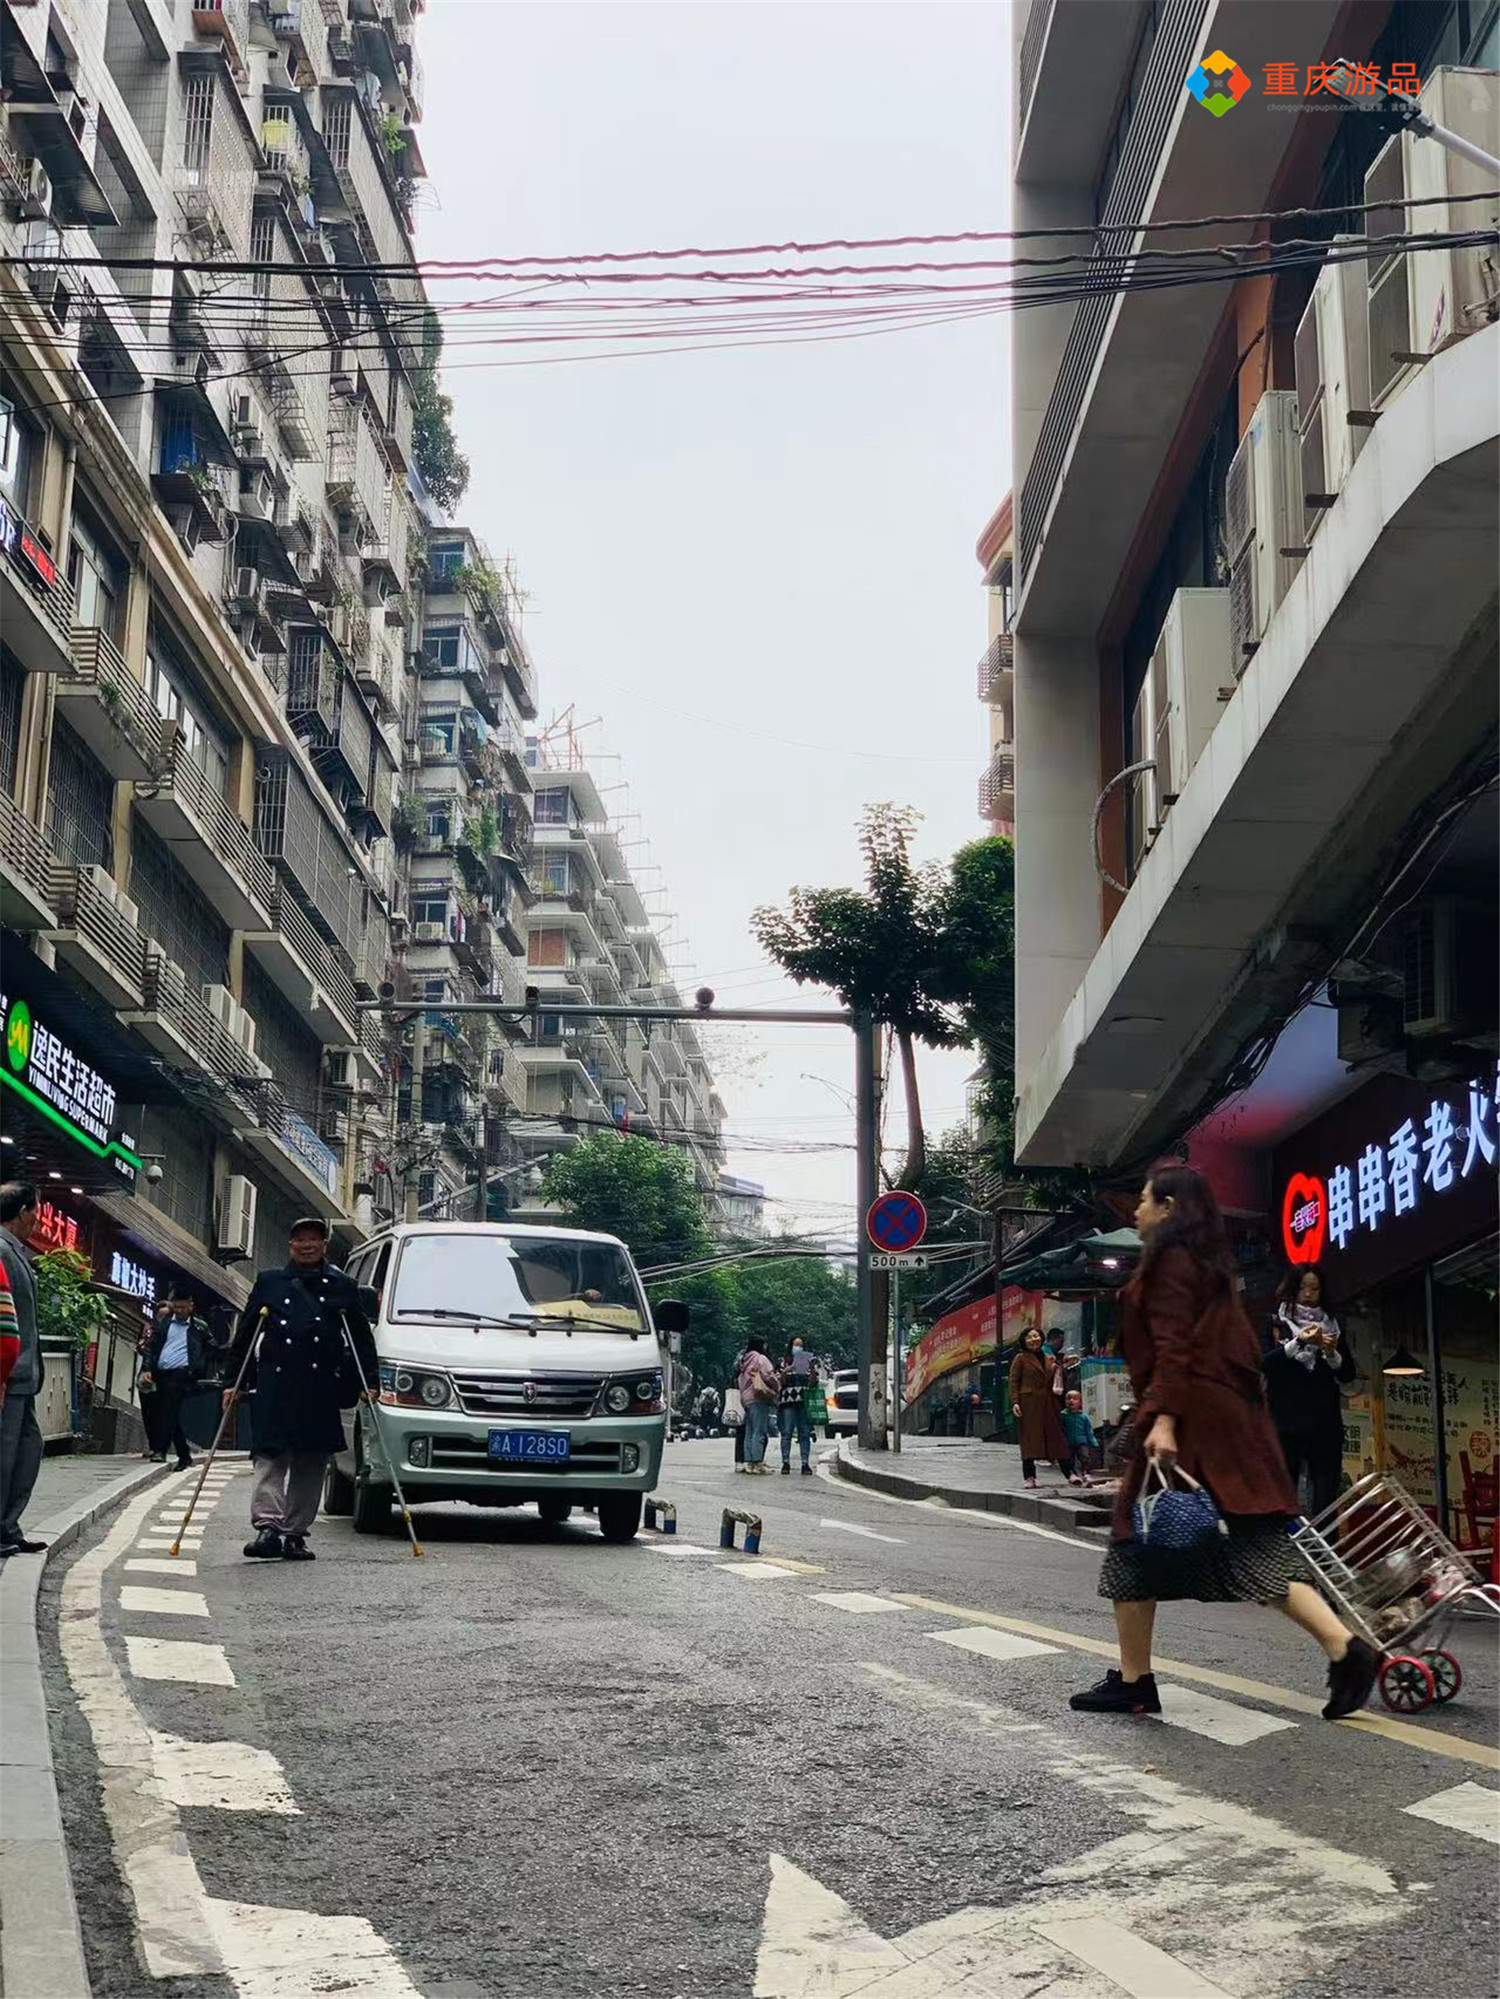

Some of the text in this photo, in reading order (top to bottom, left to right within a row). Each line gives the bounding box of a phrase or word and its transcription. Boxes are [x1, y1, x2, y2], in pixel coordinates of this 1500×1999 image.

[30, 1020, 116, 1126] 逸民生活超市
[1328, 1059, 1500, 1250] 串串香老火
[37, 1201, 78, 1251] 兴大厦
